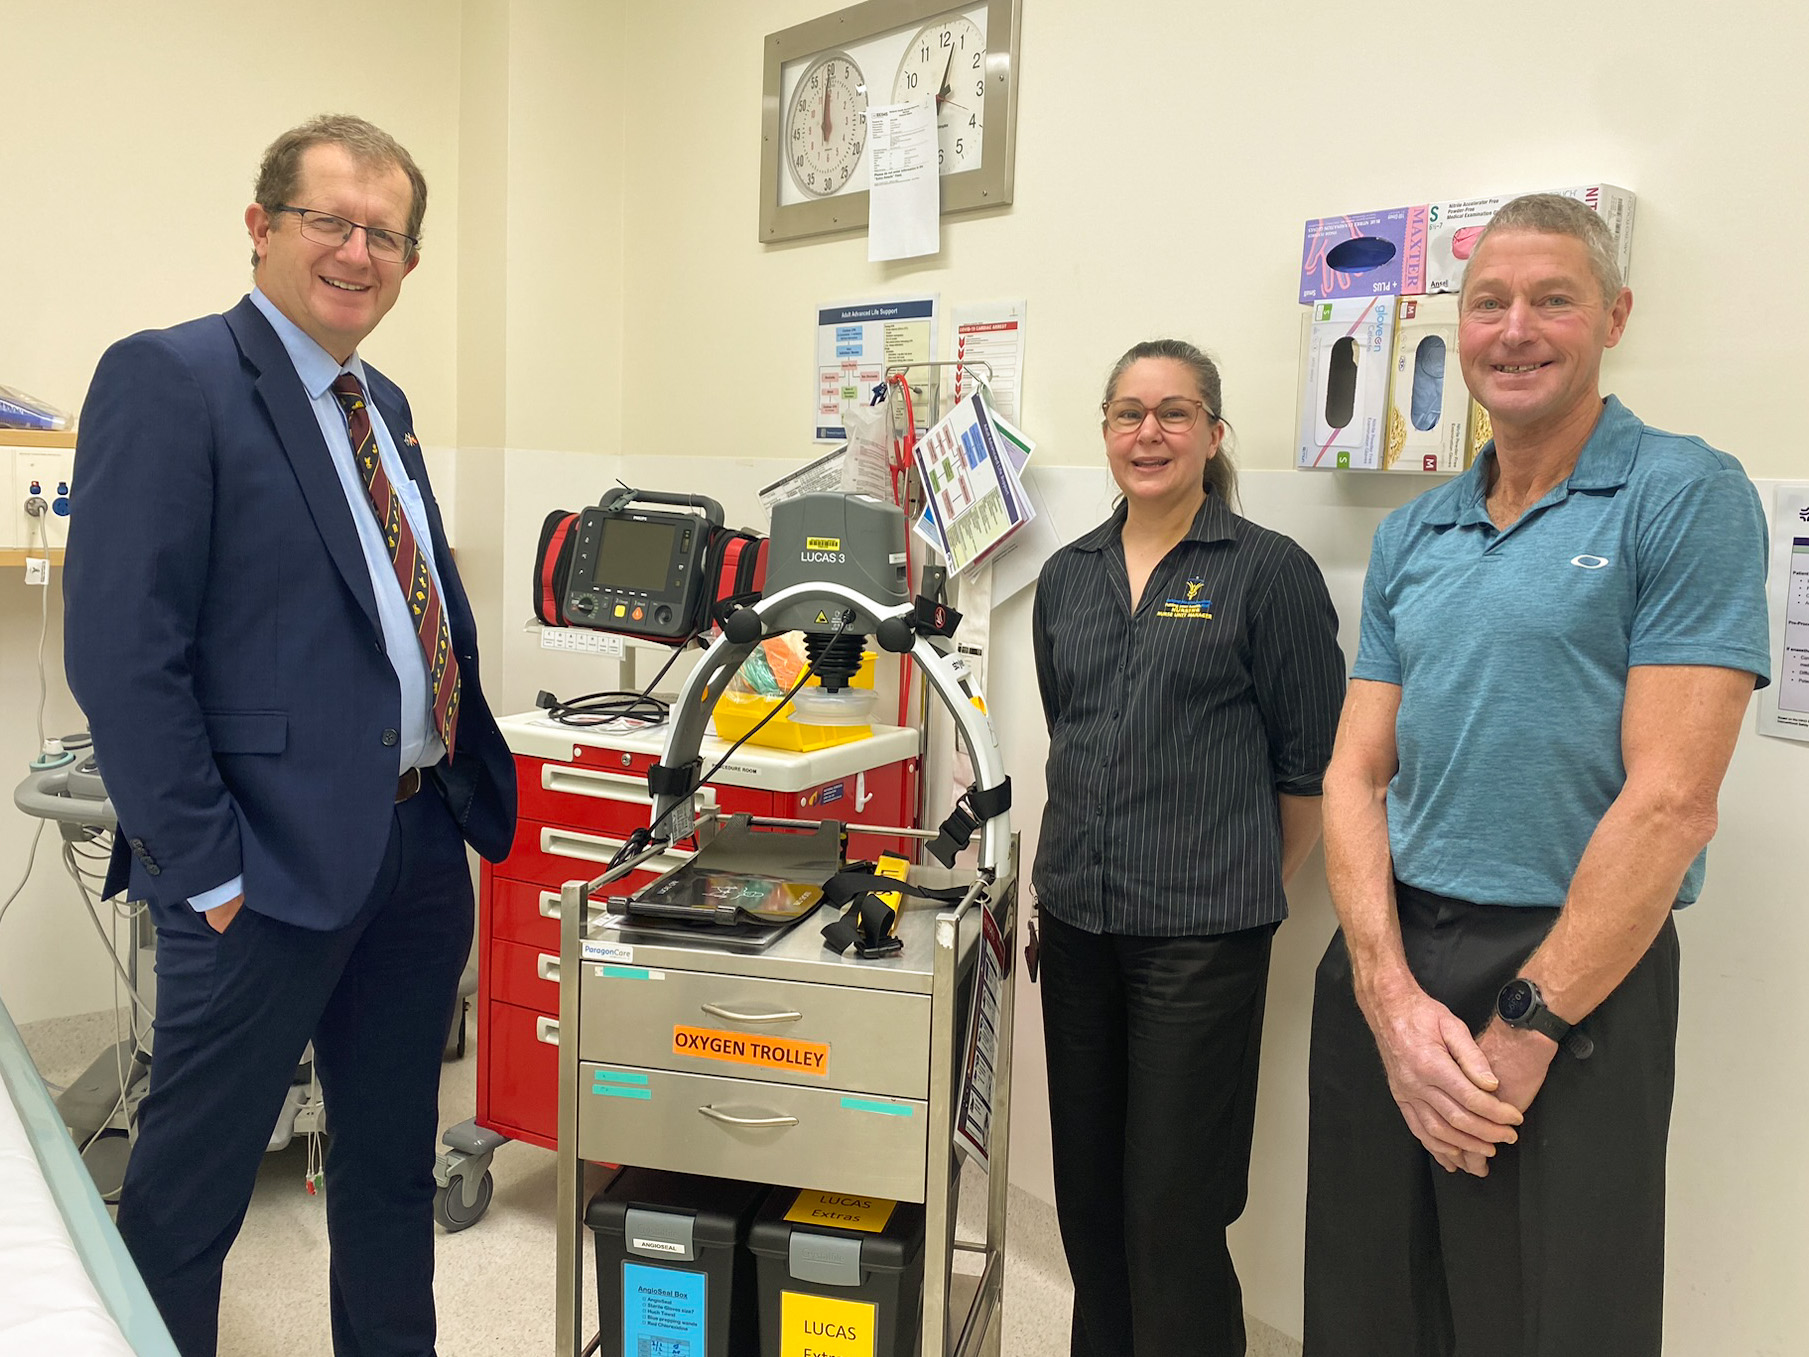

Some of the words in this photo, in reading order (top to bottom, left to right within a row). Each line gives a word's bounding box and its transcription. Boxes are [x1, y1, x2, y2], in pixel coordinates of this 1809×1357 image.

[940, 30, 952, 48] 12
[960, 33, 965, 50] 1
[921, 46, 930, 63] 11
[972, 52, 981, 69] 2
[844, 66, 850, 79] 5
[811, 76, 819, 90] 55
[907, 72, 918, 90] 10
[975, 80, 984, 97] 3
[798, 99, 807, 113] 50
[968, 113, 976, 129] 4
[793, 128, 801, 141] 45
[852, 141, 861, 155] 20
[955, 138, 964, 154] 5
[796, 154, 805, 168] 40
[807, 172, 815, 186] 35
[840, 165, 849, 180] 25
[824, 177, 833, 191] 30
[1463, 199, 1489, 207] Accelerator
[1429, 205, 1439, 222] S
[1464, 210, 1493, 218] Examination
[1407, 208, 1426, 288] MAXTER
[1304, 289, 1317, 298] Small
[1373, 281, 1391, 293] PLUS
[841, 311, 851, 319] Adult
[851, 309, 871, 318] Advanced
[871, 308, 879, 316] Life
[880, 307, 898, 315] Support
[1407, 305, 1415, 315] M
[1425, 458, 1435, 468] M
[801, 551, 837, 563] LUCAS
[838, 552, 846, 564] 3
[711, 763, 741, 772] PCEDURE
[585, 945, 631, 958] ParagonCare
[675, 1032, 745, 1057] OXYGEN
[750, 1043, 824, 1068] TROLLEY
[819, 1195, 873, 1209] LUCAS
[811, 1209, 861, 1222] Extras
[641, 1242, 678, 1252] ANGIOSEAL
[638, 1285, 673, 1297] AngioSeal
[674, 1291, 688, 1300] Box
[659, 1317, 681, 1325] prepping
[661, 1310, 676, 1318] Towel
[803, 1319, 857, 1341] LUCAS
